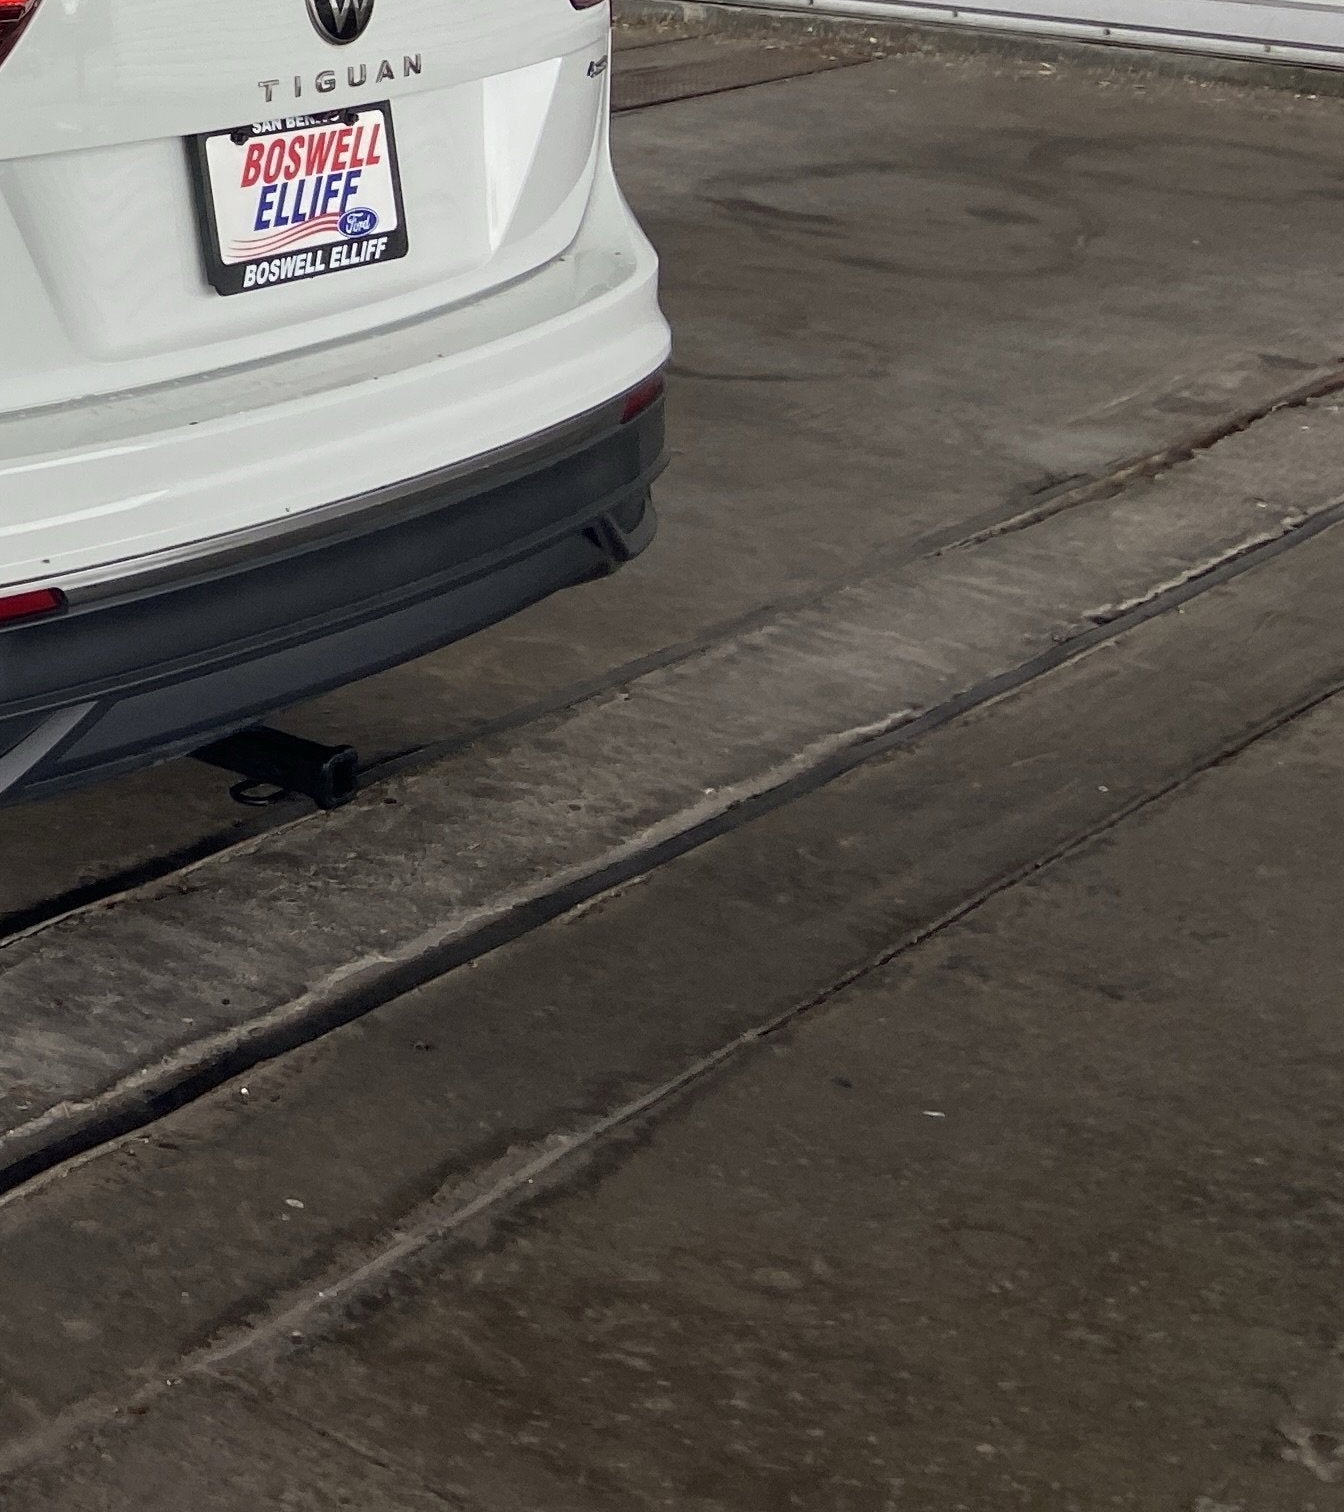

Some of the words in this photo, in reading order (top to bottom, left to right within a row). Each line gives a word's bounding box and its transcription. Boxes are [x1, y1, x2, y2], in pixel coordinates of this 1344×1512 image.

[258, 53, 422, 103] TIGUAN
[252, 118, 282, 134] SAN
[285, 111, 340, 129] BEN
[240, 123, 381, 189] BOSWELL
[253, 169, 363, 232] ELLIFF
[344, 212, 372, 235] Ford
[242, 250, 326, 288] BOSWELL
[329, 236, 389, 269] ELLIFF
